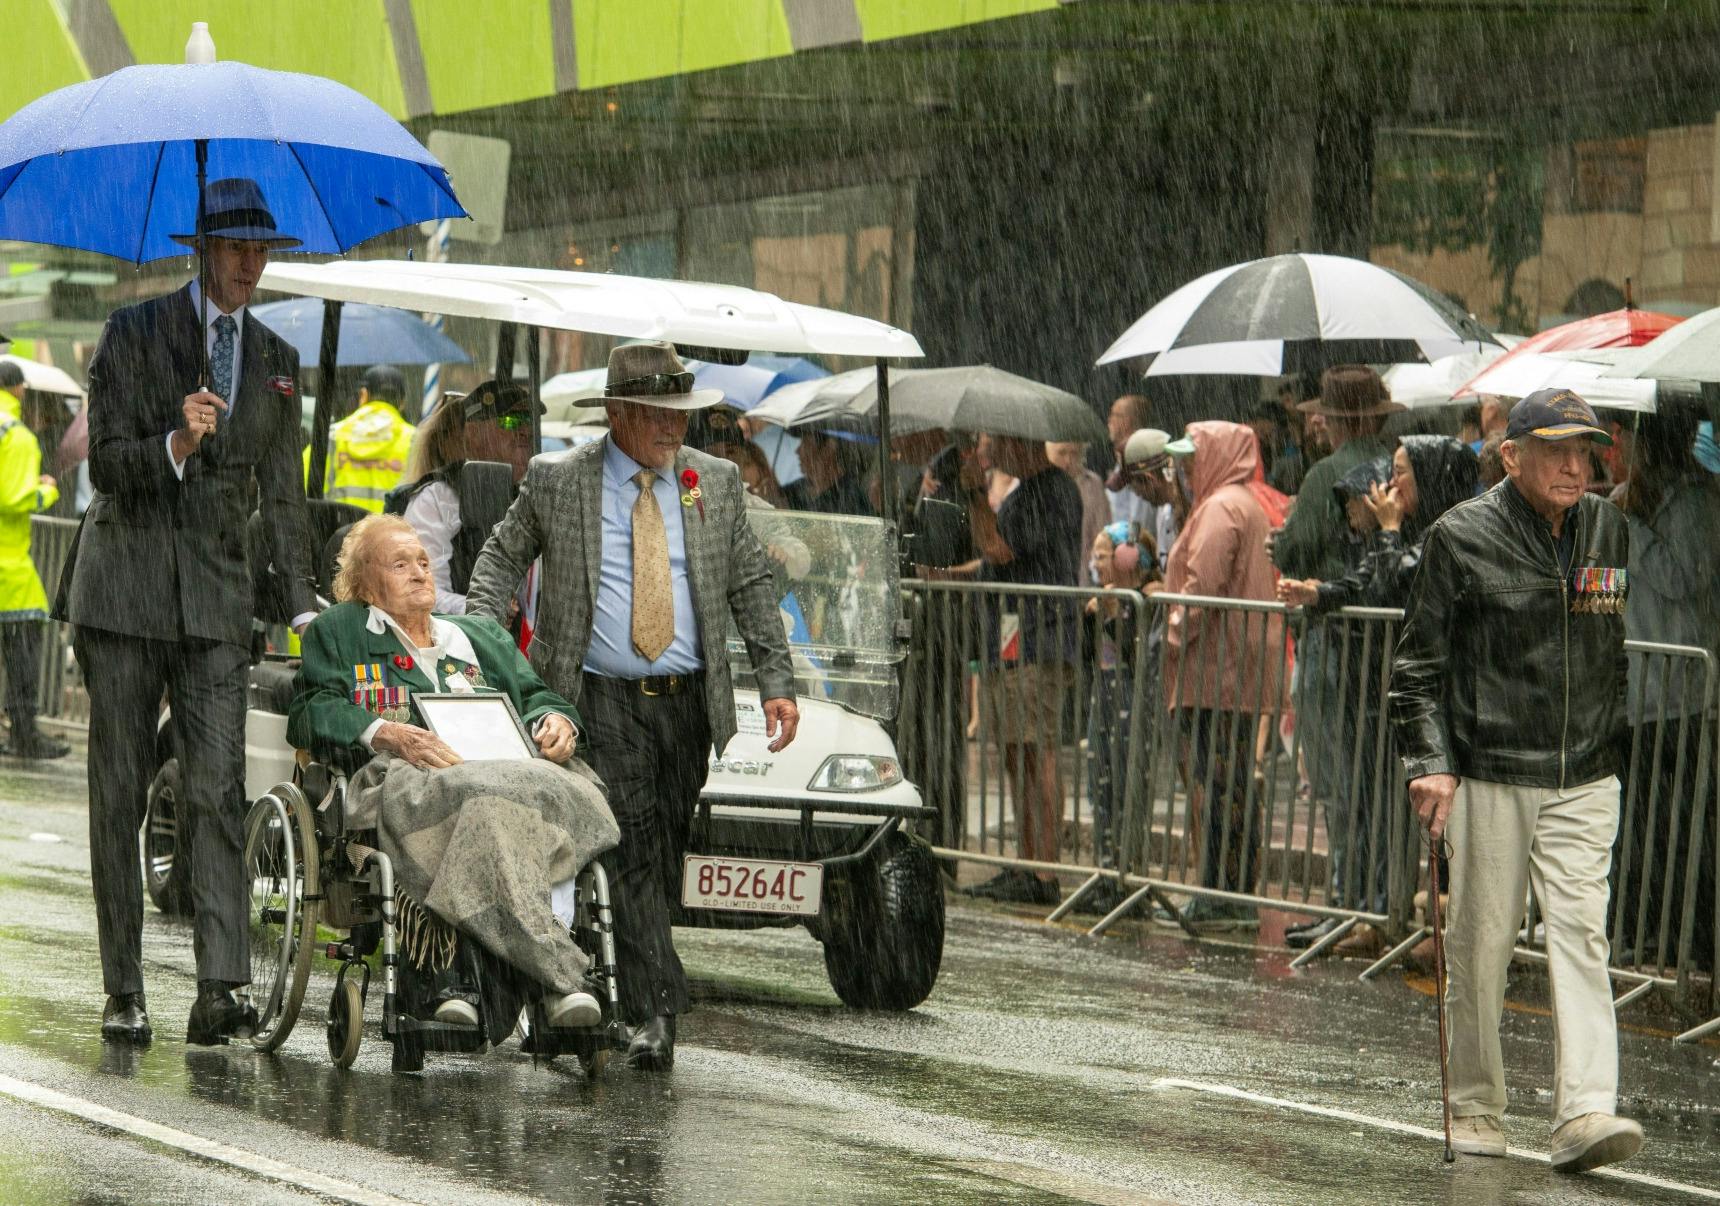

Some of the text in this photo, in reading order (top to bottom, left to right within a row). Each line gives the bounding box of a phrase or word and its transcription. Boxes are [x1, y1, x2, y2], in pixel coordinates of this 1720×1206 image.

[698, 864, 807, 902] 85264C
[760, 902, 777, 911] USE
[780, 903, 801, 912] ONLY
